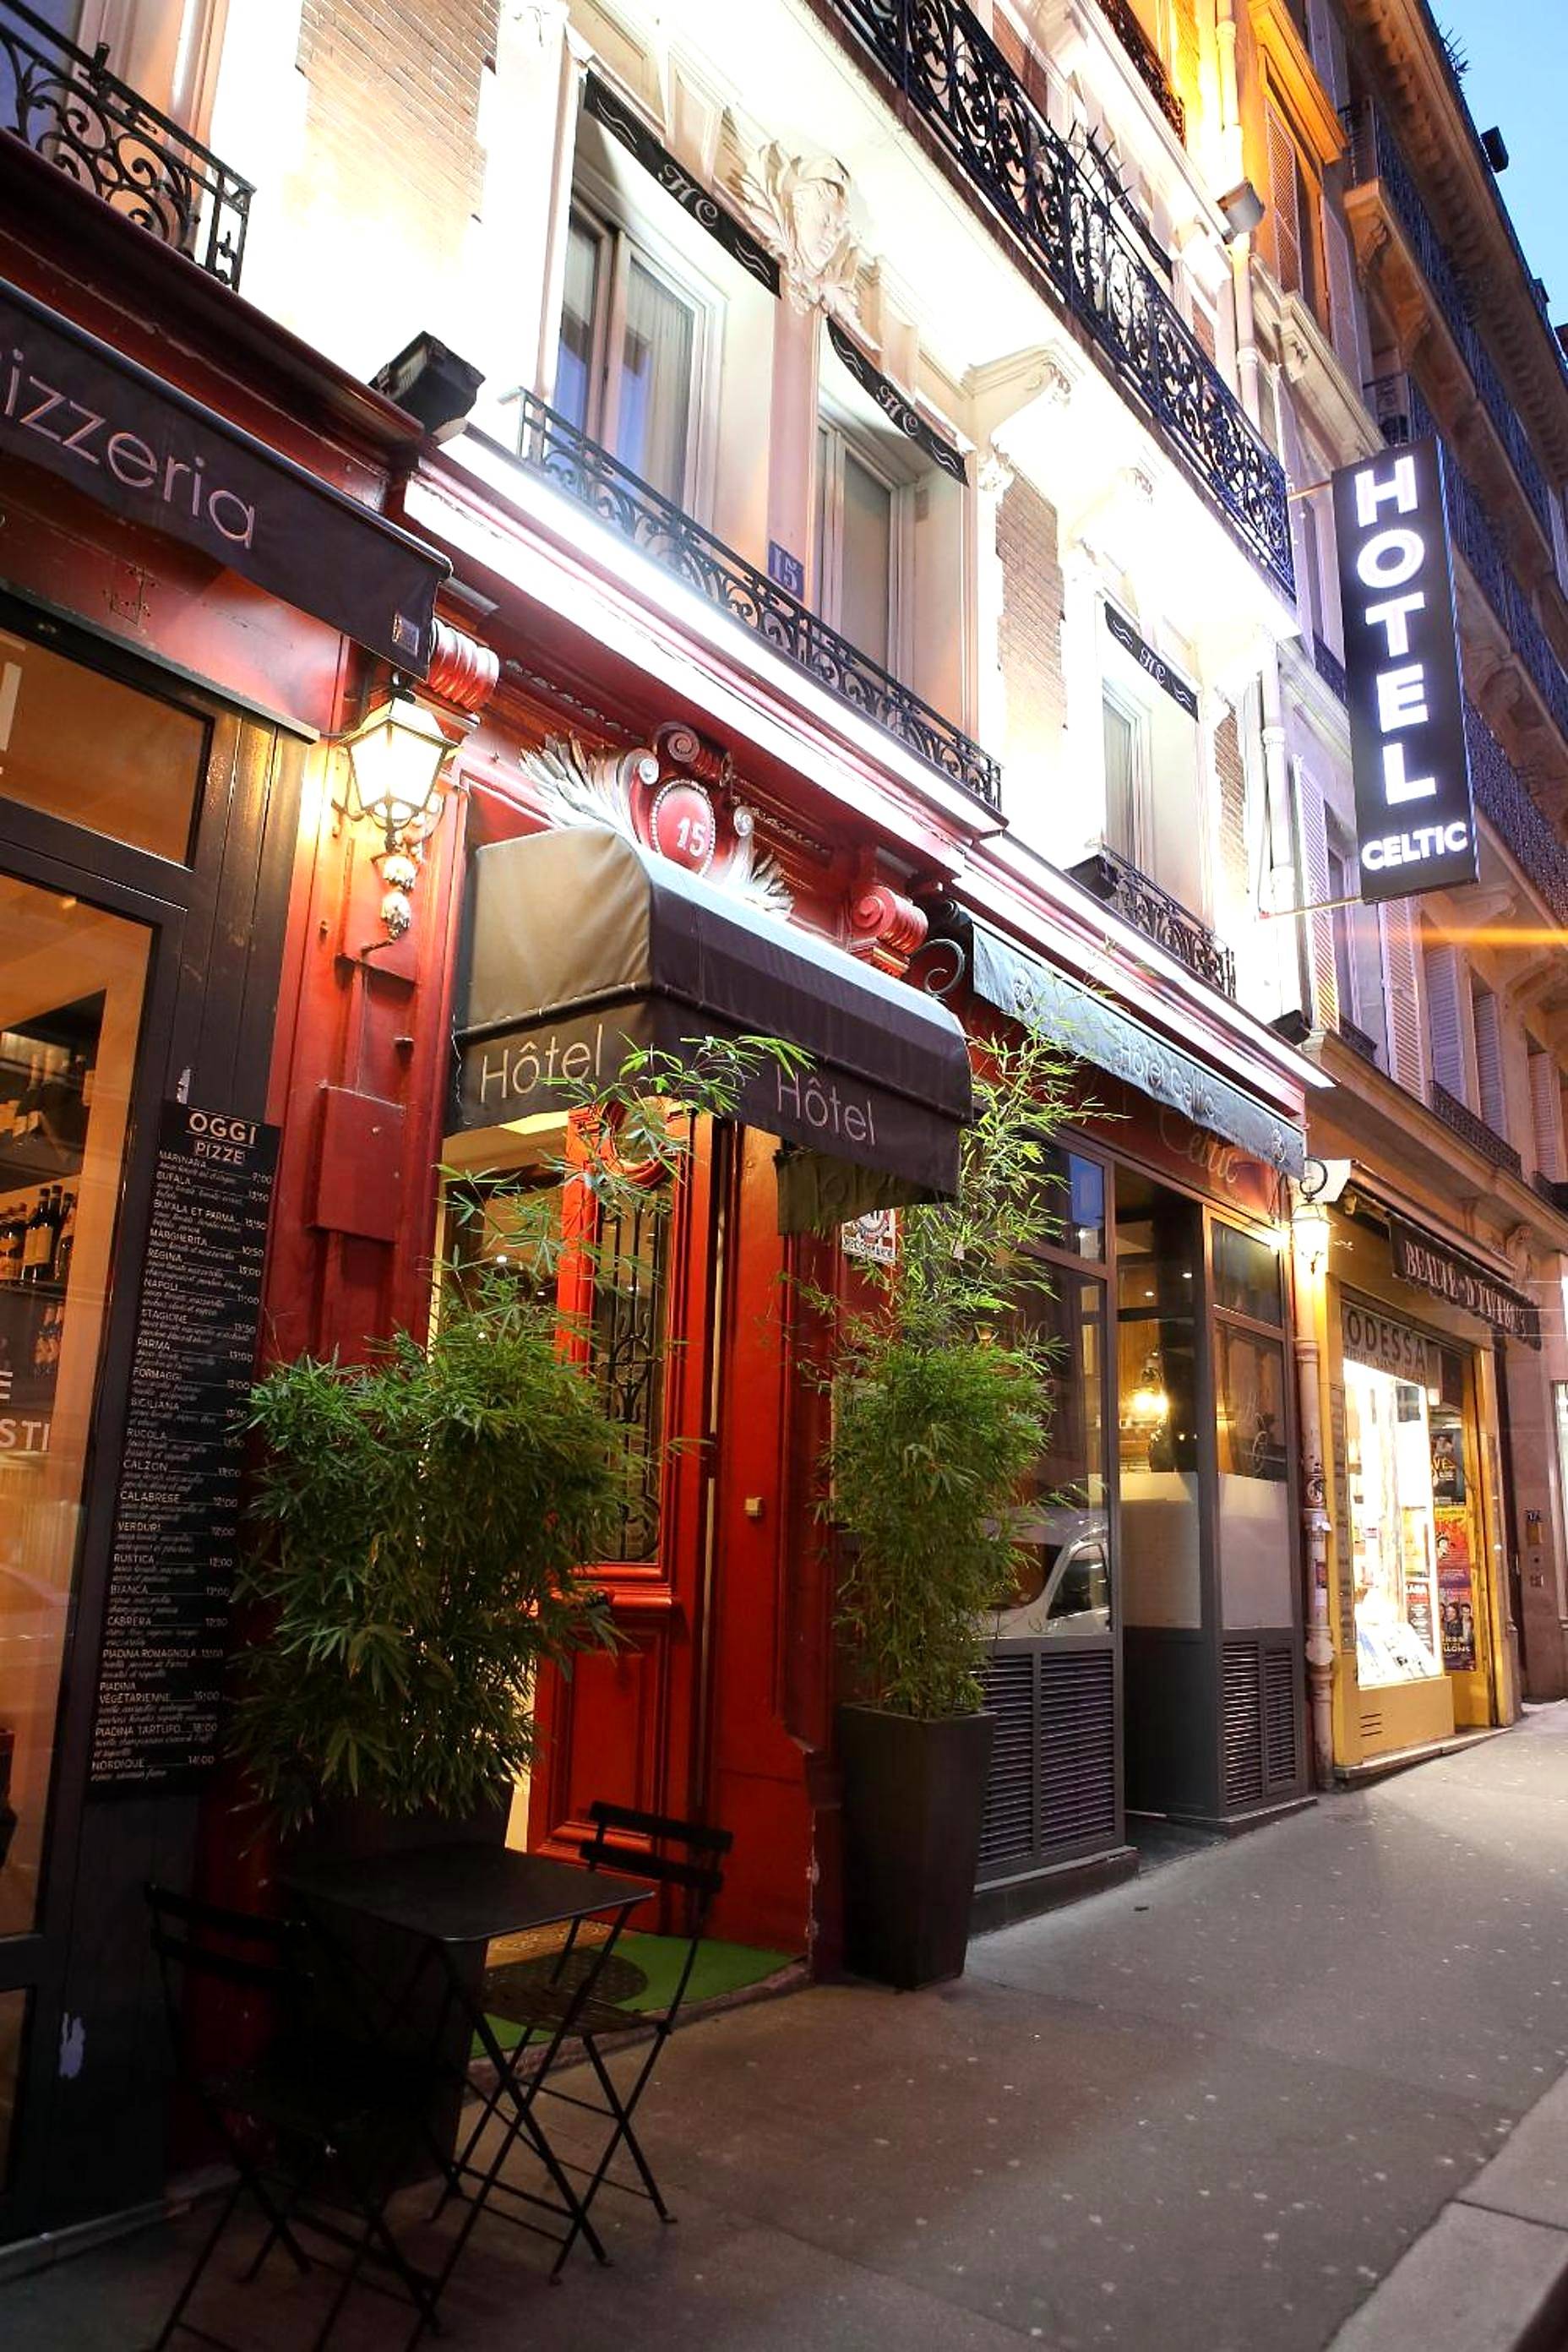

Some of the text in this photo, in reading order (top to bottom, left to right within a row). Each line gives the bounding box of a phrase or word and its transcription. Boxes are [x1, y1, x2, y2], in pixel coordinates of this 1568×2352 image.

[0, 347, 254, 549] izzeria
[773, 547, 798, 591] 15
[1354, 455, 1437, 806] HOTEL
[676, 816, 705, 858] 15
[1361, 822, 1468, 871] CELTIC
[480, 1023, 603, 1104] Hôtel
[776, 1064, 876, 1146] Hôtel
[188, 1112, 257, 1146] OGGI
[194, 1141, 246, 1165] PIZZE
[190, 1207, 204, 1217] ET
[150, 1228, 209, 1247] MARGHERITA
[148, 1247, 183, 1262] REGINA
[143, 1277, 178, 1292] NAPOLI
[141, 1308, 188, 1325] STAGIONE
[137, 1337, 171, 1351] PARMA
[1347, 1309, 1427, 1373] ODESSA
[126, 1427, 167, 1440] RUCOLA
[119, 1490, 181, 1504] CALABRESE
[113, 1552, 155, 1564] RUSTICA
[110, 1583, 149, 1596] BIANCA
